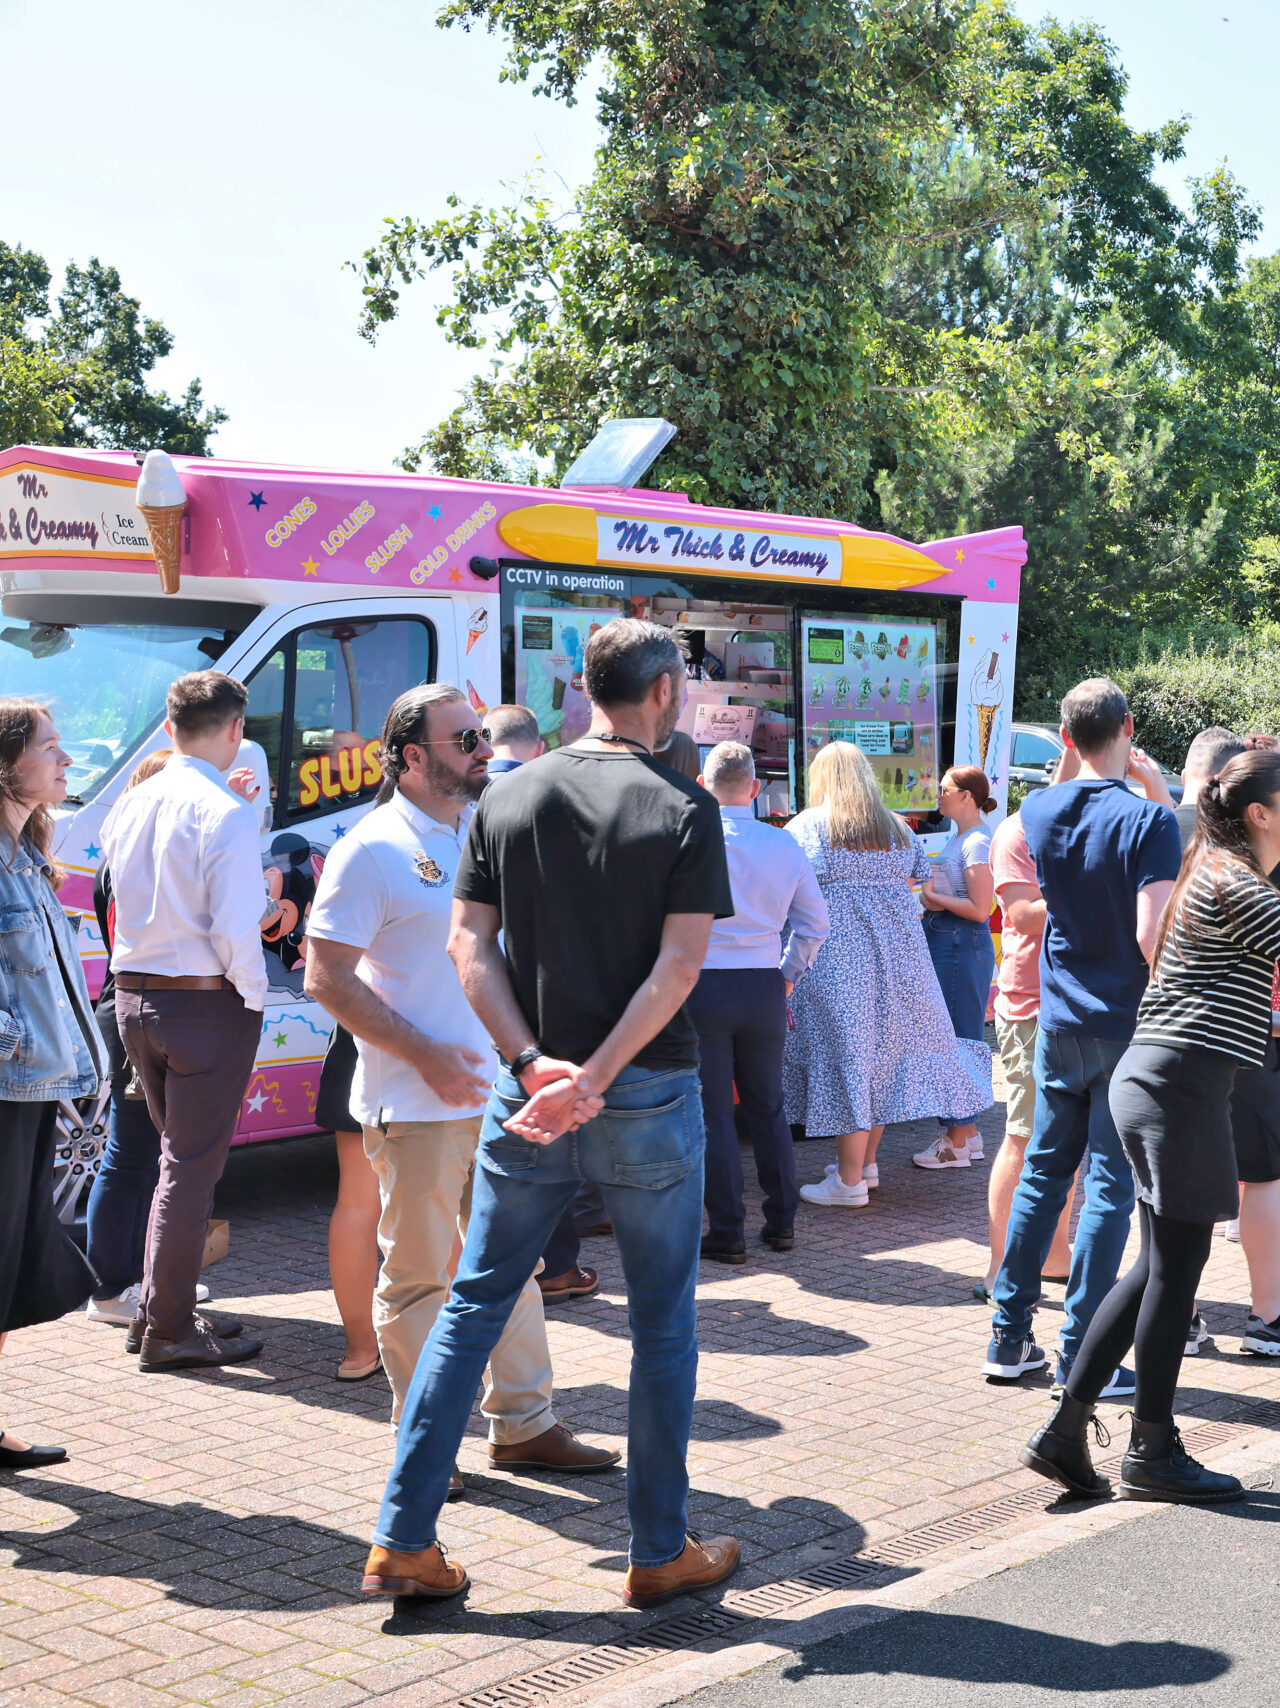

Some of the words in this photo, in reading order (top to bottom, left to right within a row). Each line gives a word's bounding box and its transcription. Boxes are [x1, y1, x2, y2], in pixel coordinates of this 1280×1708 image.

[17, 473, 48, 499] Mr
[9, 507, 22, 541] &
[26, 506, 98, 549] Creamy
[112, 531, 149, 546] Cream
[115, 514, 134, 528] Ice
[265, 496, 317, 547] CONES
[320, 500, 375, 555] LOLLIES
[410, 546, 448, 584] COLD
[446, 501, 497, 551] DRINKS
[365, 524, 413, 573] SLUSH
[613, 520, 660, 554] Mr
[663, 526, 724, 560] Thick
[728, 533, 746, 562] &
[749, 535, 829, 576] Creamy
[506, 568, 542, 585] CCTV
[546, 570, 559, 586] in
[562, 572, 624, 592] operation
[299, 739, 383, 807] SLUS
